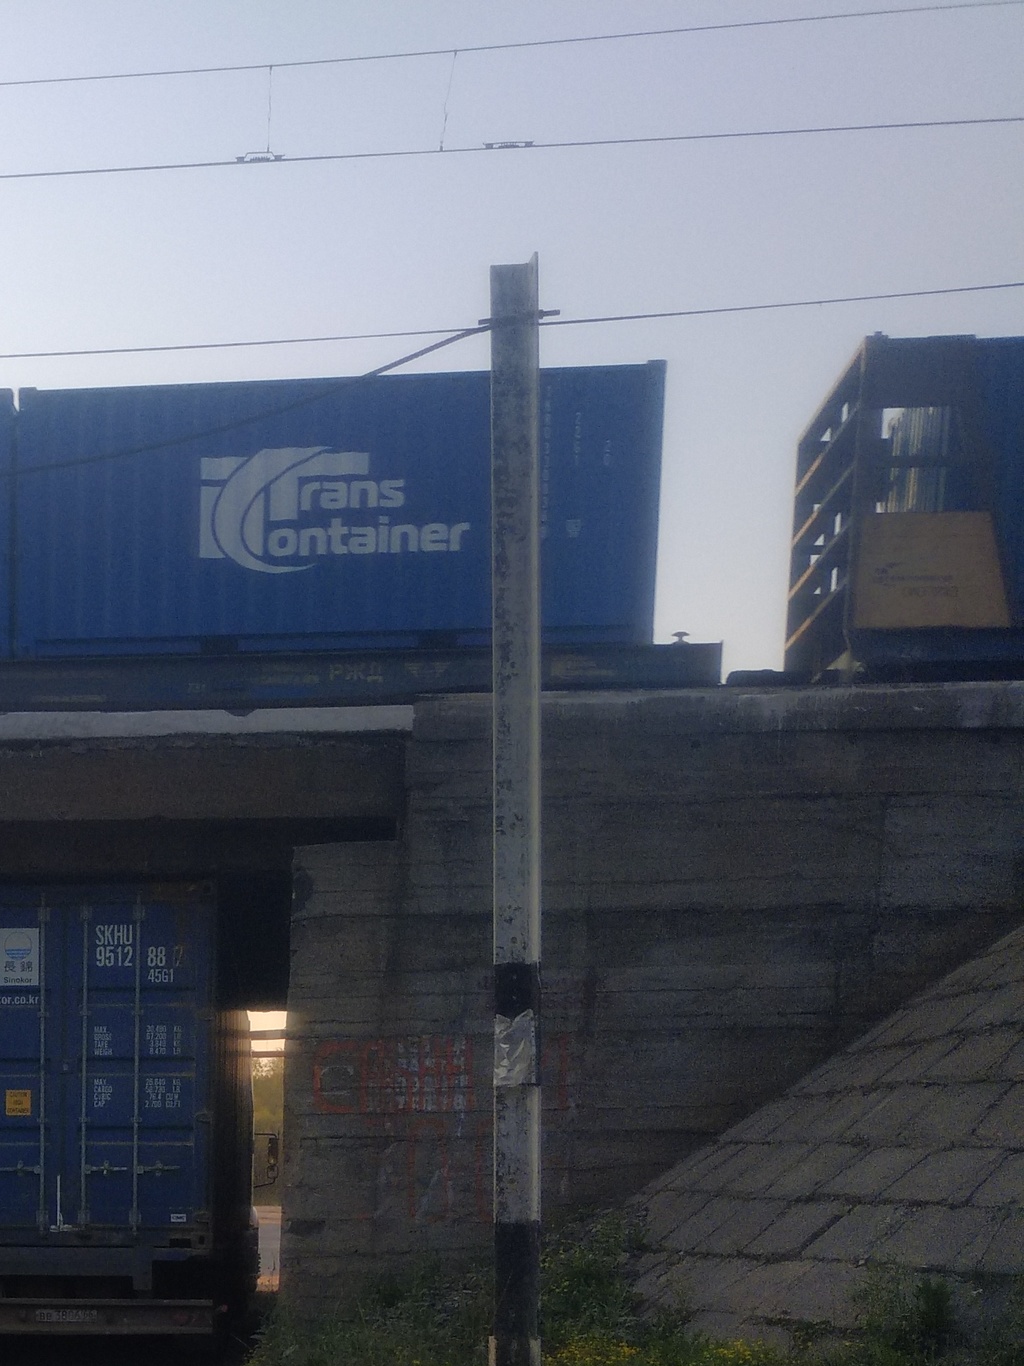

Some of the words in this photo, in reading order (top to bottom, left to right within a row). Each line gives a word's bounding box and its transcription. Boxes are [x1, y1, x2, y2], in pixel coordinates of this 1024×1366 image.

[329, 662, 384, 684] РЖД
[95, 924, 133, 945] SKHU
[95, 945, 133, 967] 9512
[147, 945, 166, 967] 88
[4, 976, 32, 984] Sinokor
[147, 968, 174, 983] 45G1
